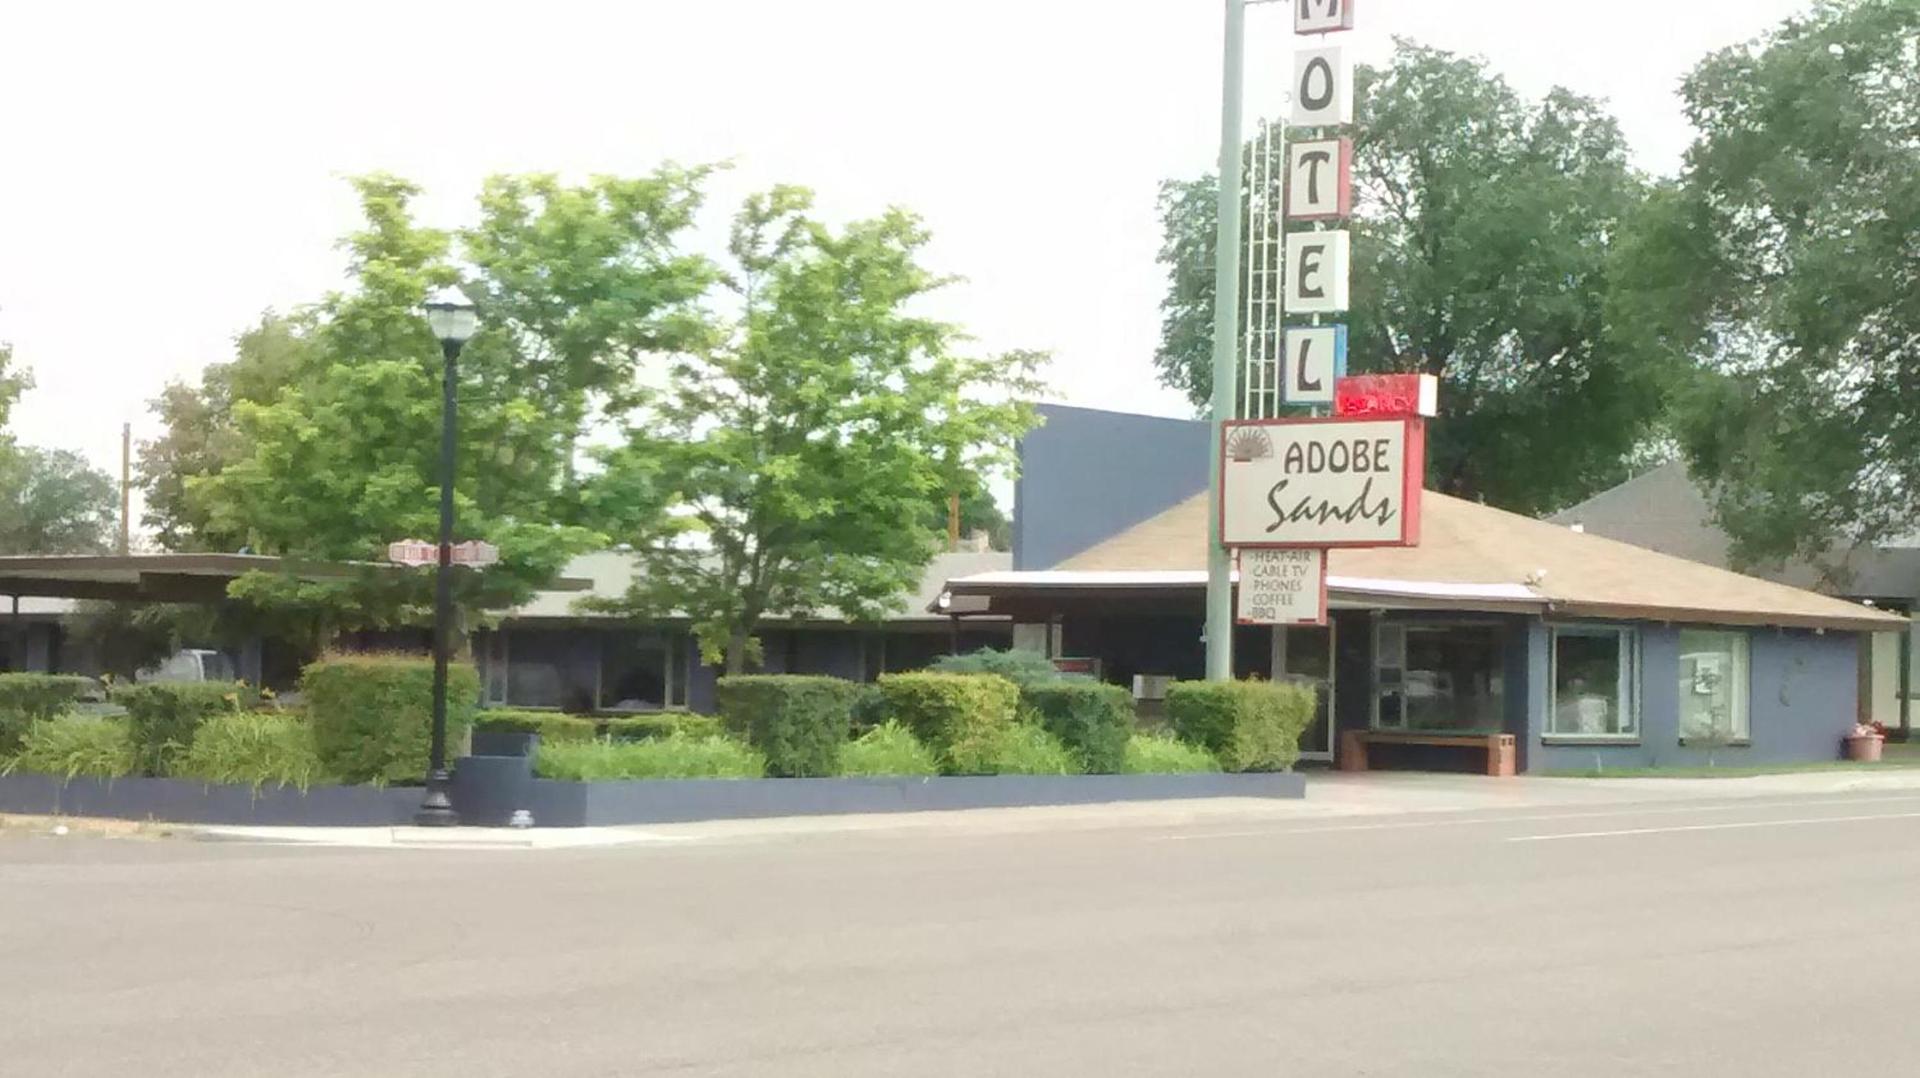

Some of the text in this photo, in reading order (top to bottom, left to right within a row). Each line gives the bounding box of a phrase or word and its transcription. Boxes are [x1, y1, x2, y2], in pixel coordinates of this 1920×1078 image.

[1284, 439, 1391, 474] ADOBE
[1265, 477, 1397, 533] Sands
[1252, 564, 1309, 577] CABLE TV
[1253, 579, 1303, 592] PHONES
[1251, 593, 1294, 606] COFFEE
